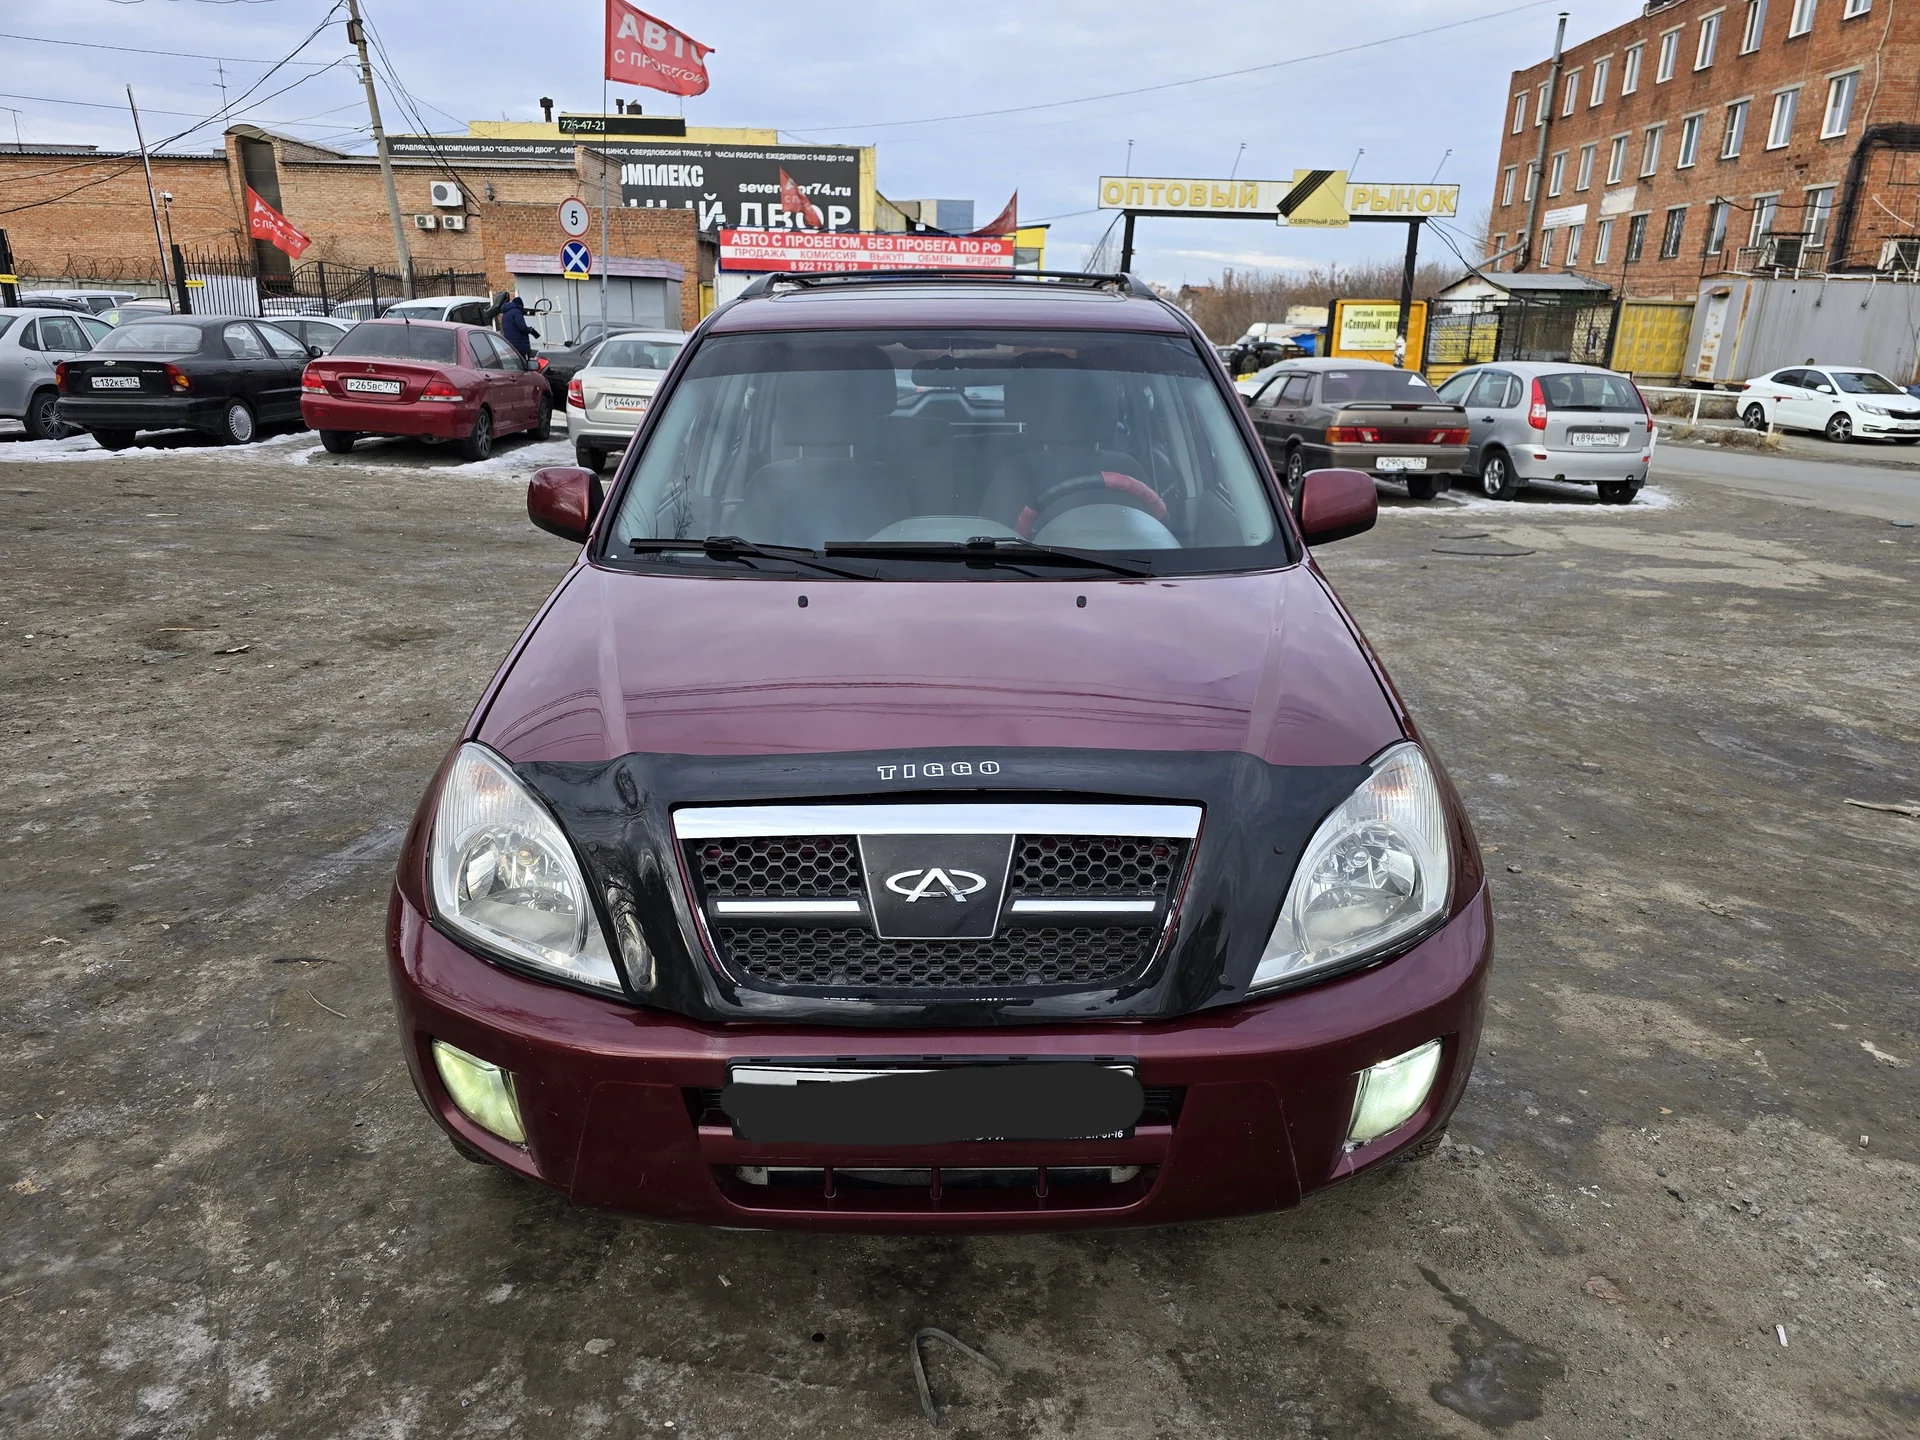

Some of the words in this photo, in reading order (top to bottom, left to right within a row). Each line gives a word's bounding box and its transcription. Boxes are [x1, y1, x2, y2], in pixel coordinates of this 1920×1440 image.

[614, 49, 625, 63] С
[630, 51, 705, 84] ПРОБЕГОМ
[445, 144, 480, 153] КОМПАНИЯ
[481, 145, 494, 153] ЗАО
[630, 148, 681, 157] СВЕРДЛОВСКИЙ
[682, 150, 704, 158] ТРАКТ,
[766, 153, 806, 161] ЕЖЕДНЕВНО
[739, 183, 851, 197] severor74.ru
[1103, 181, 1259, 208] ОПТОВЫЙ
[1351, 188, 1457, 212] РЫНОК
[253, 218, 260, 227] С
[571, 211, 578, 225] 5
[731, 233, 769, 245] АВТО
[772, 235, 782, 245] С
[785, 235, 864, 250] ПРОБЕГОМ,
[867, 238, 893, 250] БЕЗ
[896, 239, 957, 253] ПРОБЕГА
[961, 241, 979, 253] ПО
[982, 241, 1002, 254] РФ
[734, 248, 786, 259] ПРОДАЖА
[800, 250, 857, 260] КОМИССИЯ
[869, 252, 905, 262] ВЫКУП
[917, 254, 953, 263] ОБМЕН
[965, 256, 1003, 266] КРЕДИТ
[790, 261, 797, 270] 8
[798, 261, 814, 271] 922
[816, 262, 833, 271] 712
[848, 262, 858, 271] 12
[877, 761, 1000, 780] TIGGO
